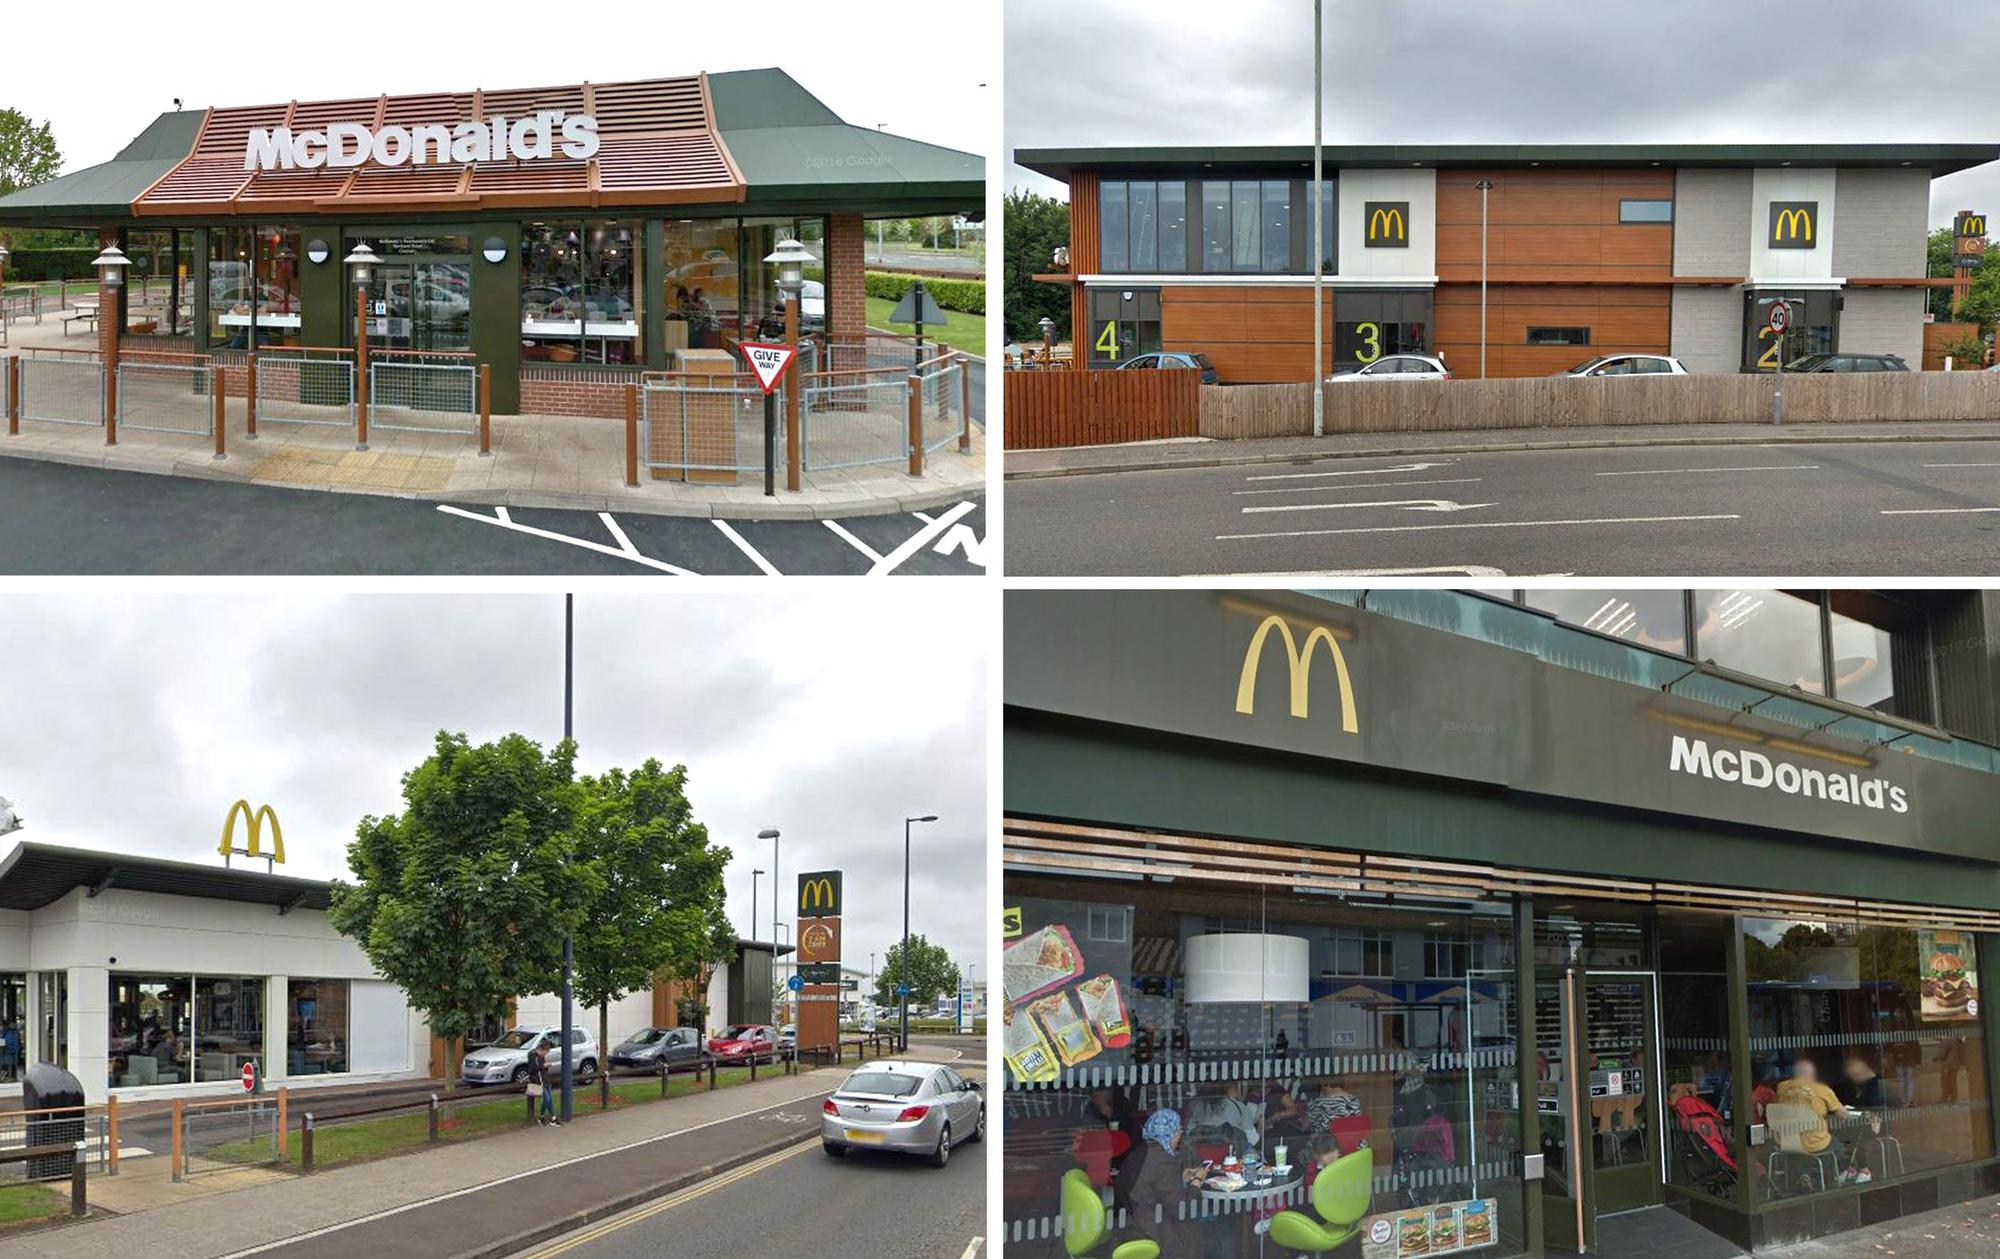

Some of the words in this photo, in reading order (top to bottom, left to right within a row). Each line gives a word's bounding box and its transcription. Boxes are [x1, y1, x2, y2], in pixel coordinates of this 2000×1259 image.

[244, 110, 600, 170] McDonald's
[1771, 312, 1785, 326] 40
[753, 350, 781, 362] GIVE
[1095, 320, 1120, 361] 4
[1355, 322, 1380, 363] 3
[758, 361, 776, 369] WAY
[1669, 735, 1908, 814] McDonald's
